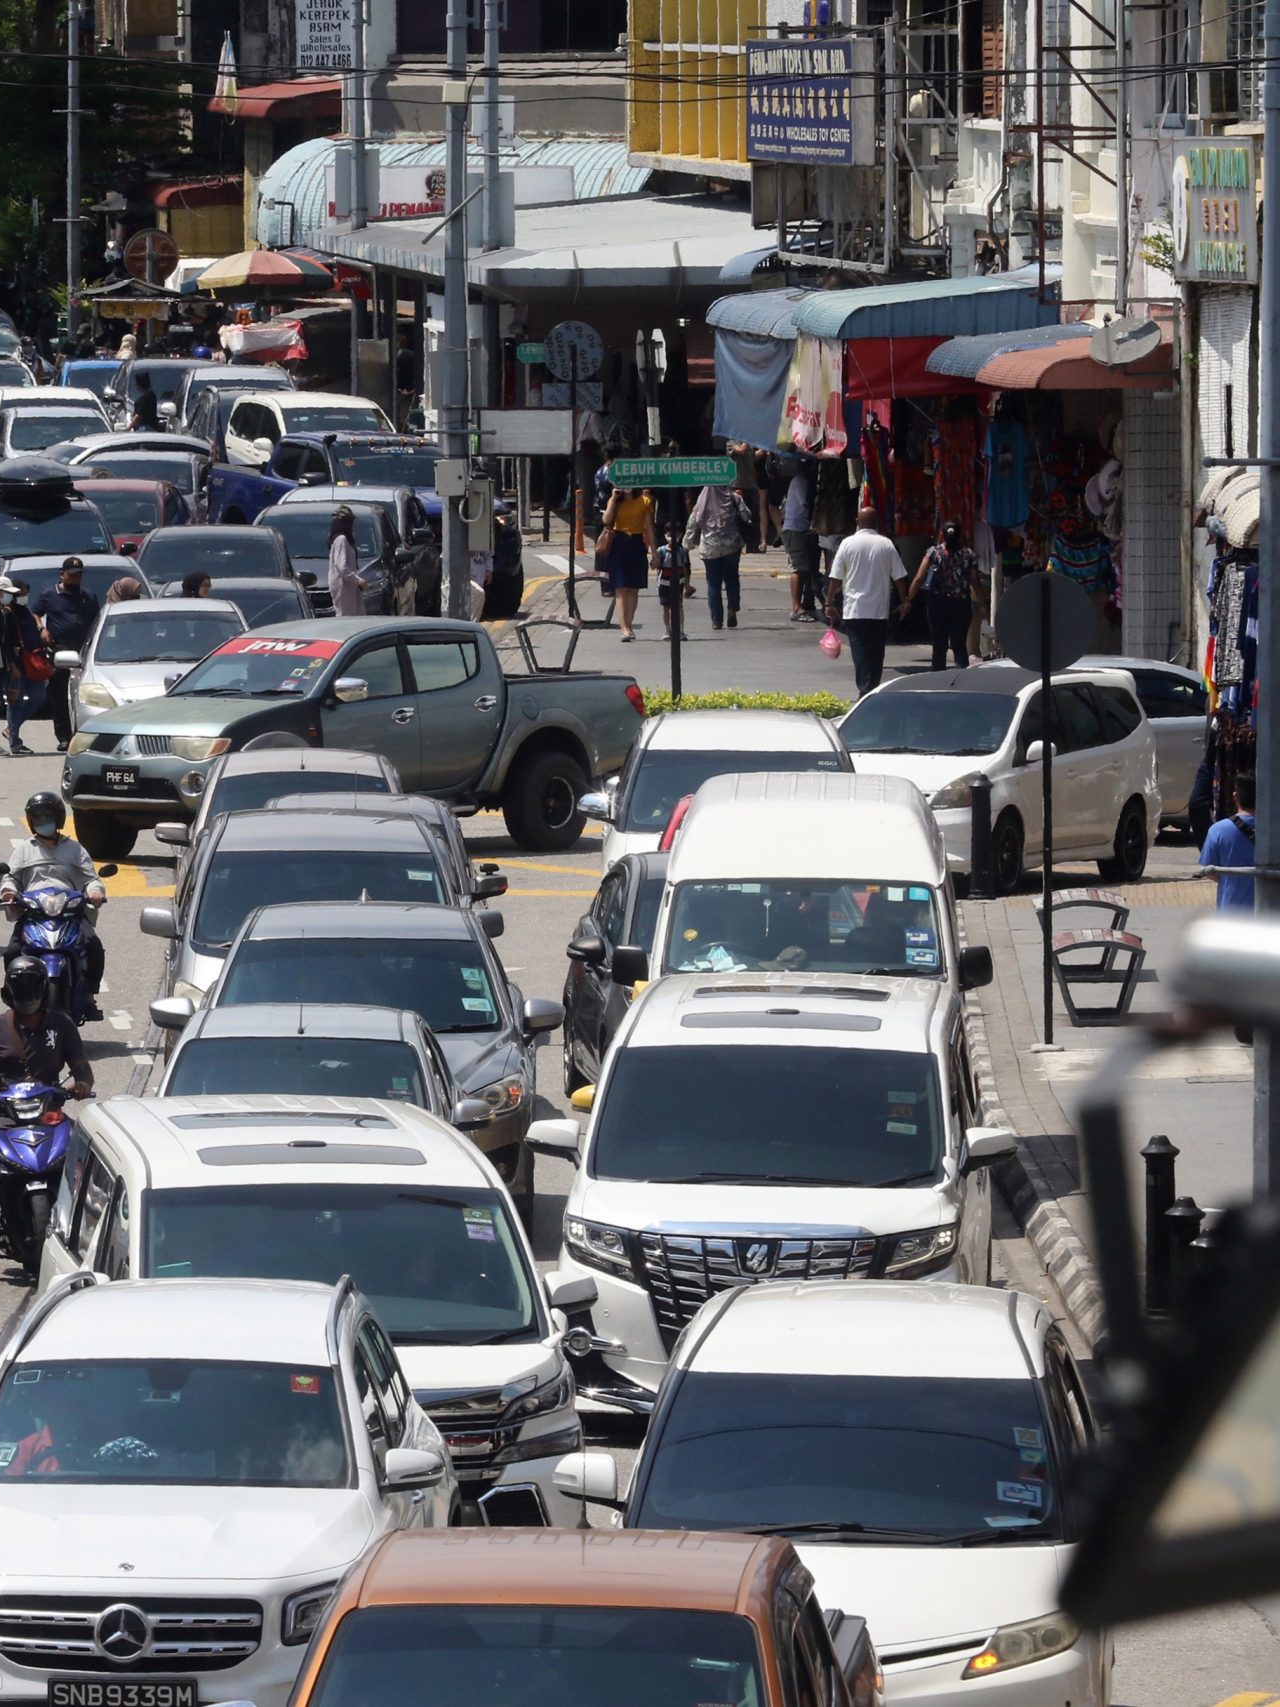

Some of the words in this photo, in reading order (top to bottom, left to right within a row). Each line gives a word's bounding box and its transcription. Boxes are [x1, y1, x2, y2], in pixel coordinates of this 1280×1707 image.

[300, 10, 351, 21] KEREPEK
[309, 22, 342, 33] ASAM
[309, 34, 333, 44] Sales
[300, 43, 352, 53] Wholesales
[785, 126, 818, 142] WHOLESALES
[819, 127, 829, 142] TOY
[829, 128, 850, 143] CENTRE
[614, 463, 656, 476] LEBUH
[659, 460, 729, 475] KIMBERLEY
[238, 640, 308, 654] jnw
[106, 771, 123, 783] PHF
[123, 772, 135, 783] 64
[53, 1684, 192, 1707] SNB9339M
